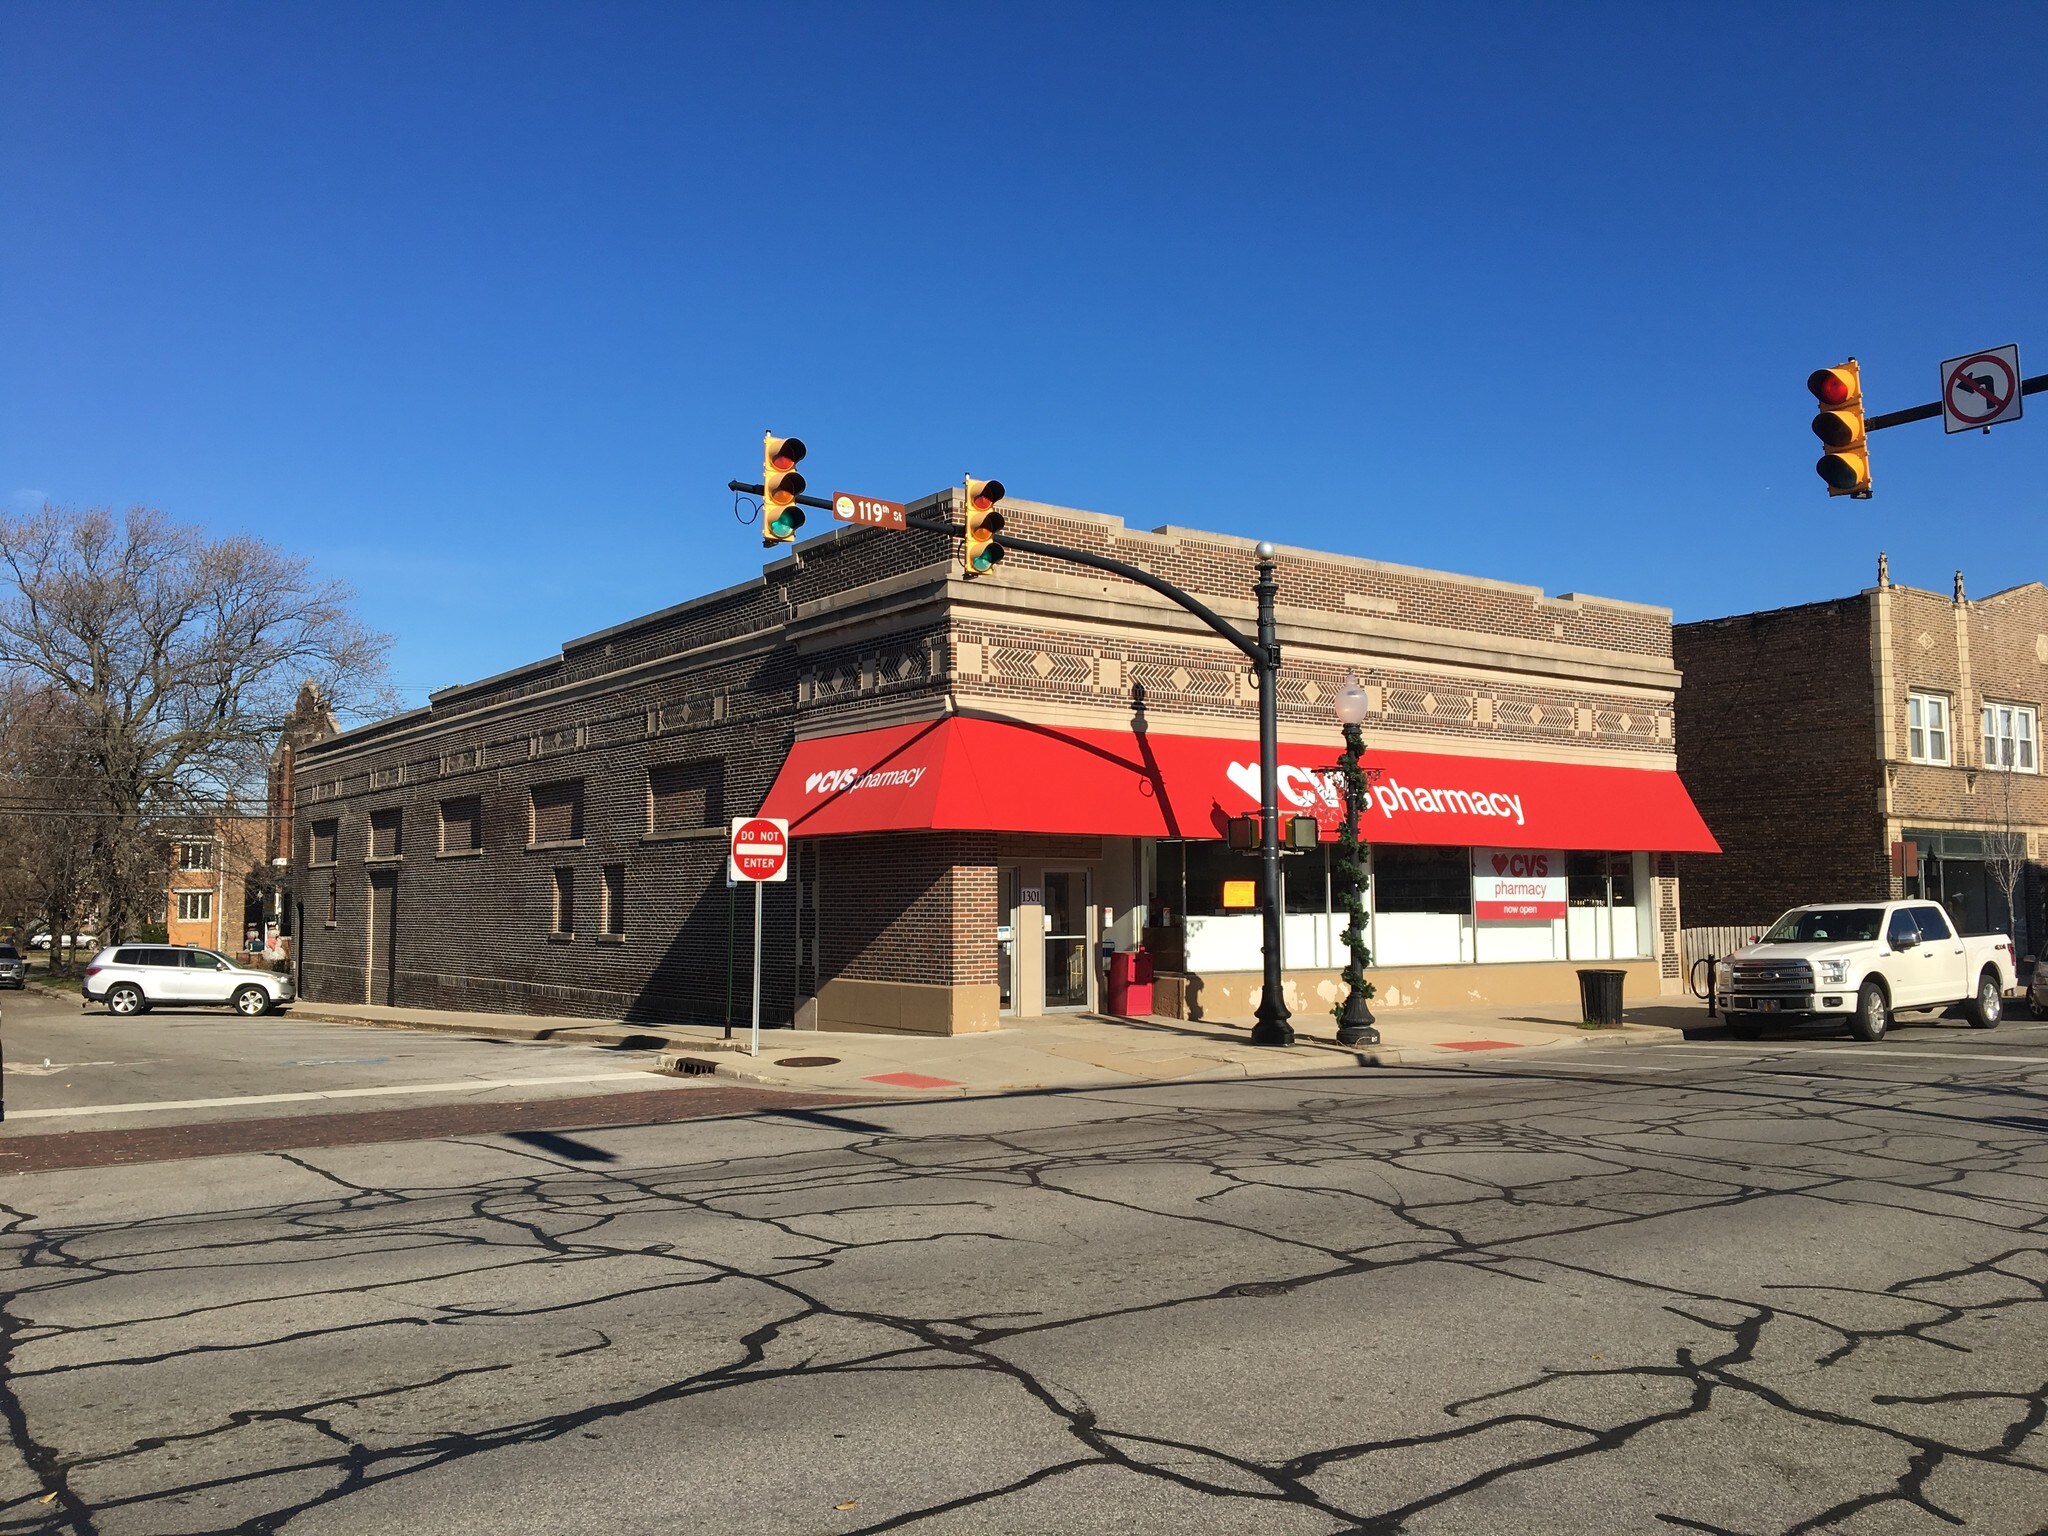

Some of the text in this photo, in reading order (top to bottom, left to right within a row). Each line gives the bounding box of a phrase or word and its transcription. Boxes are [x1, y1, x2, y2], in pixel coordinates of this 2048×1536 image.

[858, 500, 903, 522] 119th St
[818, 766, 927, 794] CVS pharmacy
[1277, 764, 1525, 825] CV pharmacy
[741, 830, 780, 842] DO NOT
[744, 858, 775, 869] ENTER
[1510, 854, 1548, 877] CVS
[1022, 890, 1040, 902] 1301
[1495, 881, 1547, 898] pharmacy
[1503, 905, 1537, 915] now open
